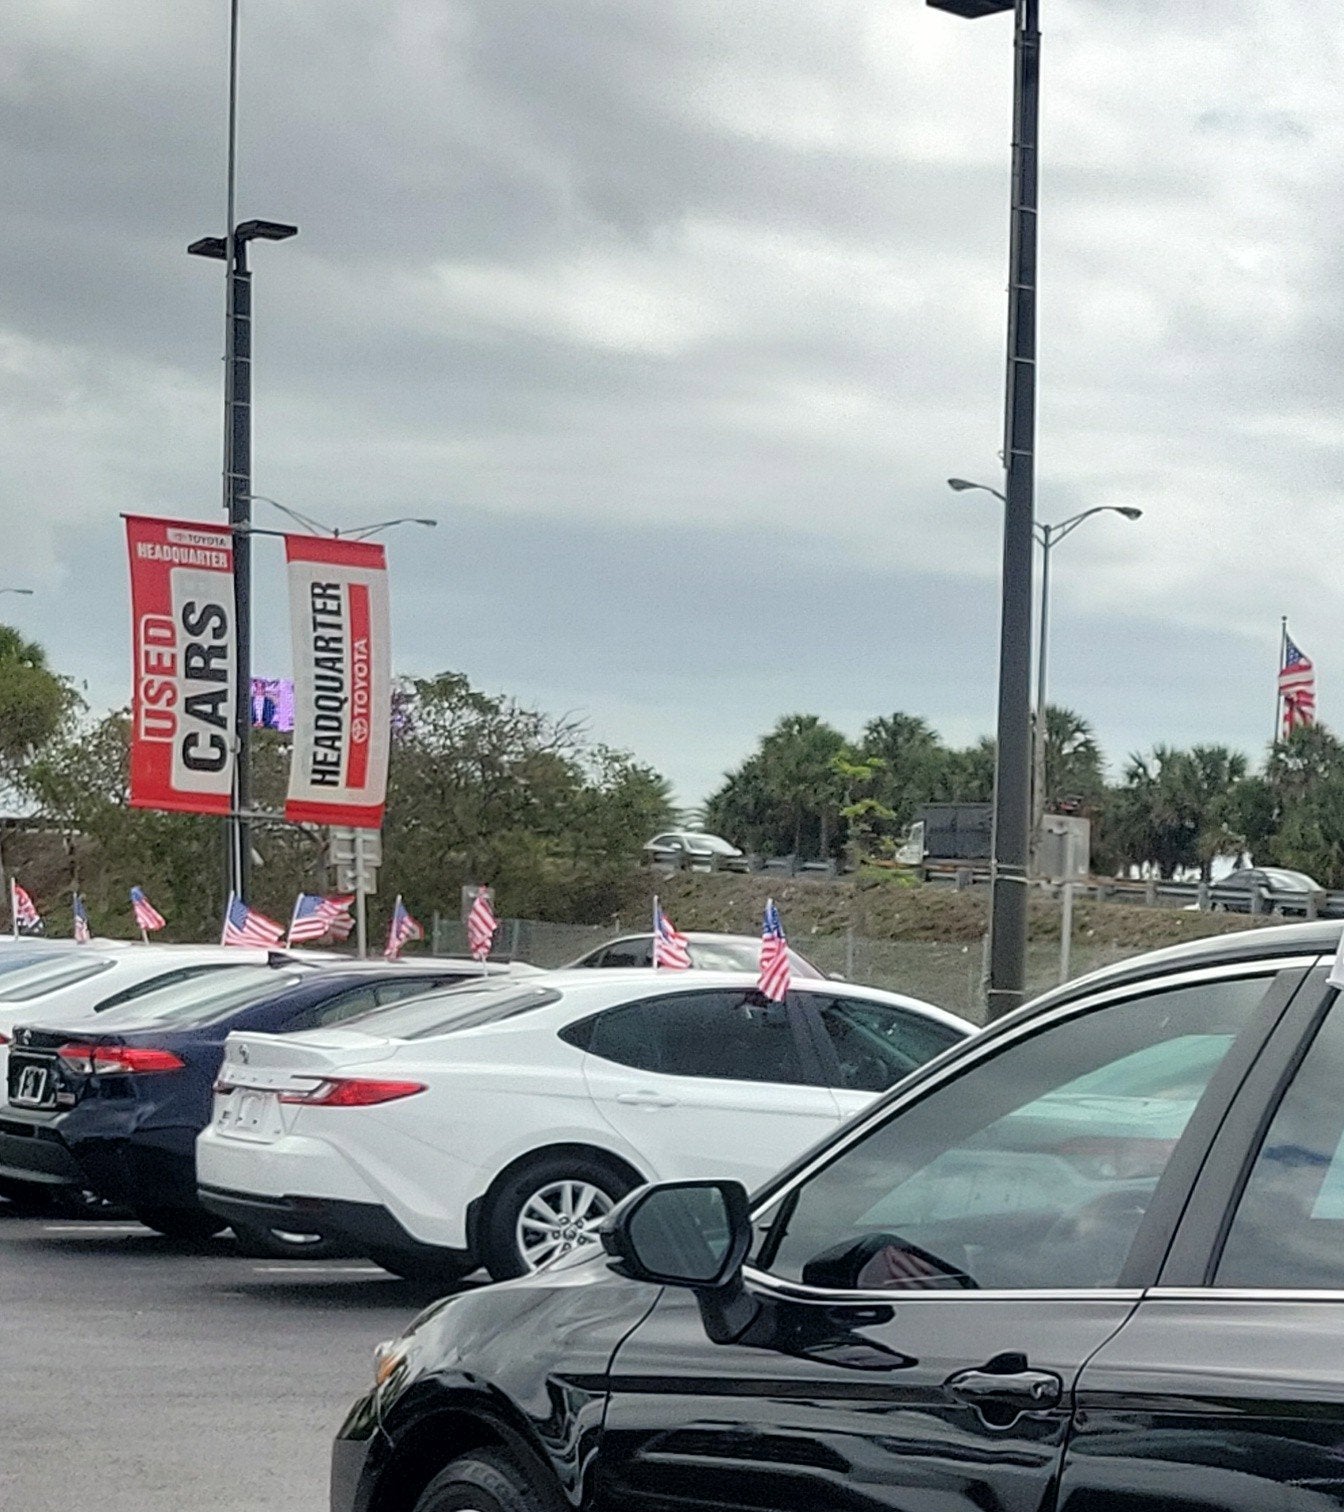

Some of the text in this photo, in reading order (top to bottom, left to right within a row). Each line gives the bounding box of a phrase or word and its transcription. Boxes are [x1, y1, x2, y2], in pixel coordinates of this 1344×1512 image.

[136, 542, 228, 568] HEADQUARTER
[188, 534, 227, 547] TOYOTA
[143, 616, 178, 736] USED
[181, 601, 228, 773] CARS
[310, 581, 348, 787] HEADQUARTER
[352, 638, 369, 717] TOYOTA
